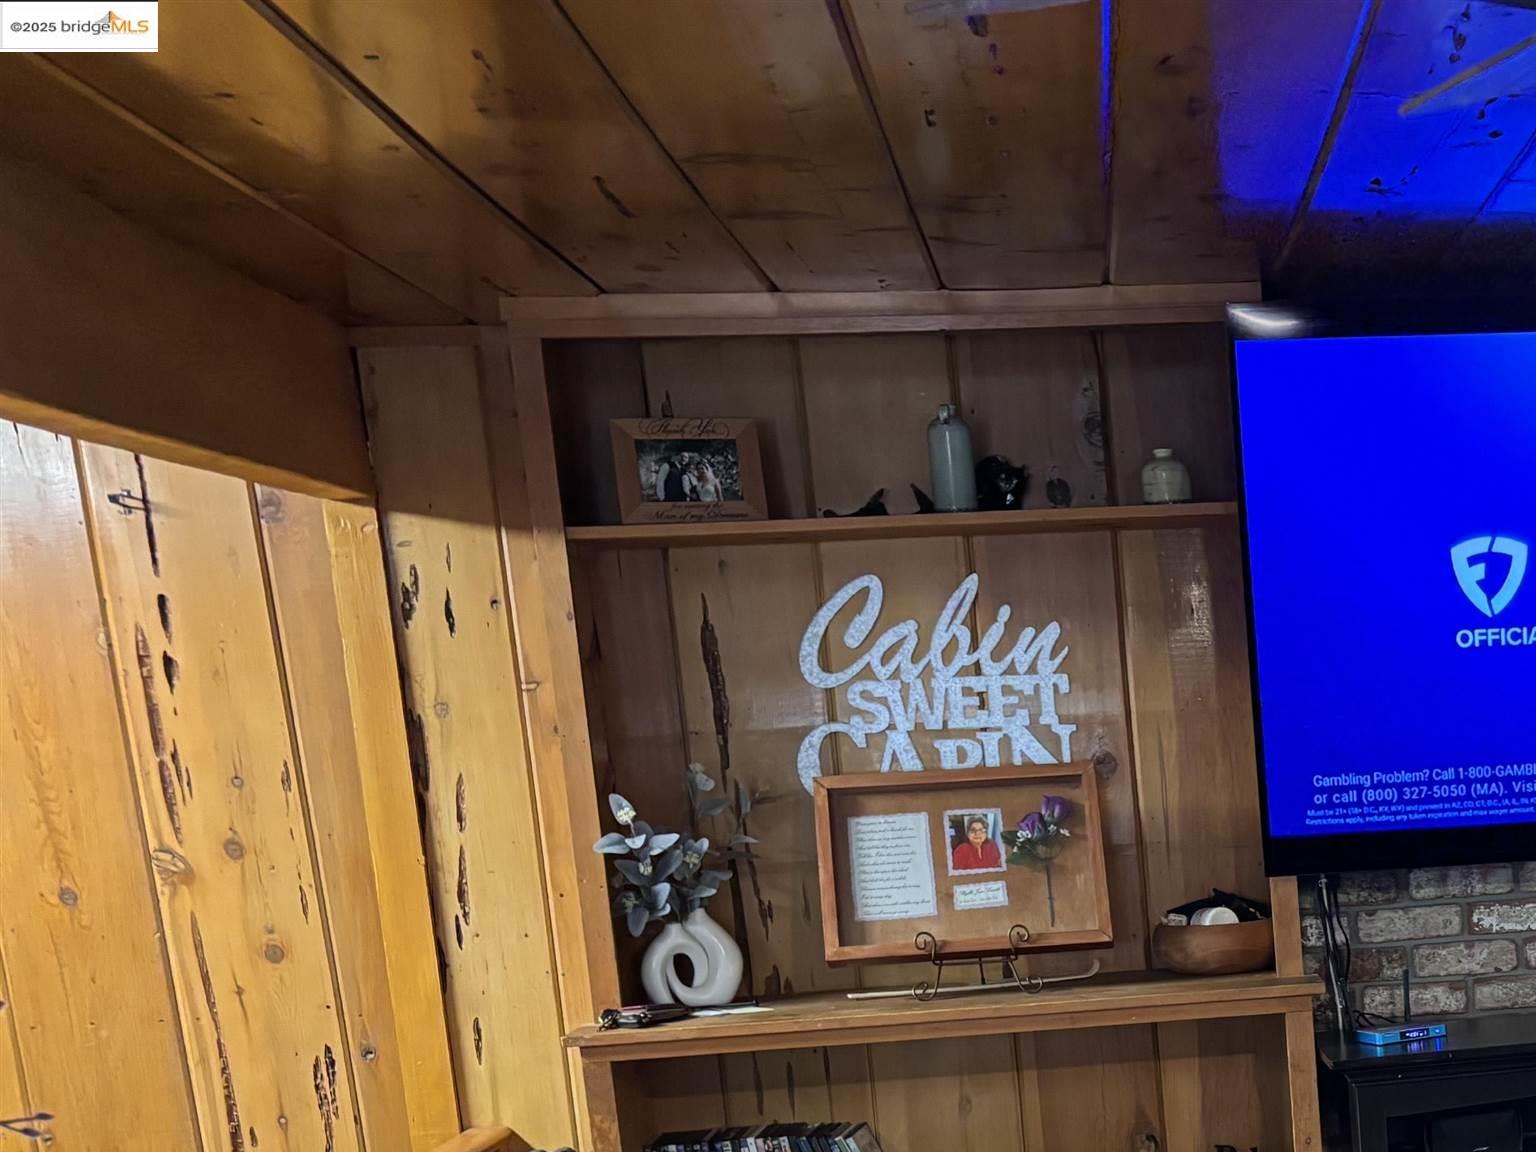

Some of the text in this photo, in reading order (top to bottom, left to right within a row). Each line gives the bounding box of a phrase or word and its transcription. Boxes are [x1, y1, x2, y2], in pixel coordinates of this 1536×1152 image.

[799, 573, 1069, 688] Cabin
[847, 673, 1070, 734] SWEET
[1313, 773, 1371, 788] Gambling
[1373, 769, 1430, 784] Problem?
[1432, 767, 1455, 781] Call
[1313, 794, 1328, 805] or
[1332, 790, 1357, 804] call
[1362, 787, 1398, 805] (800)
[1402, 783, 1466, 799] 327-5050
[1471, 781, 1508, 798] (MA).
